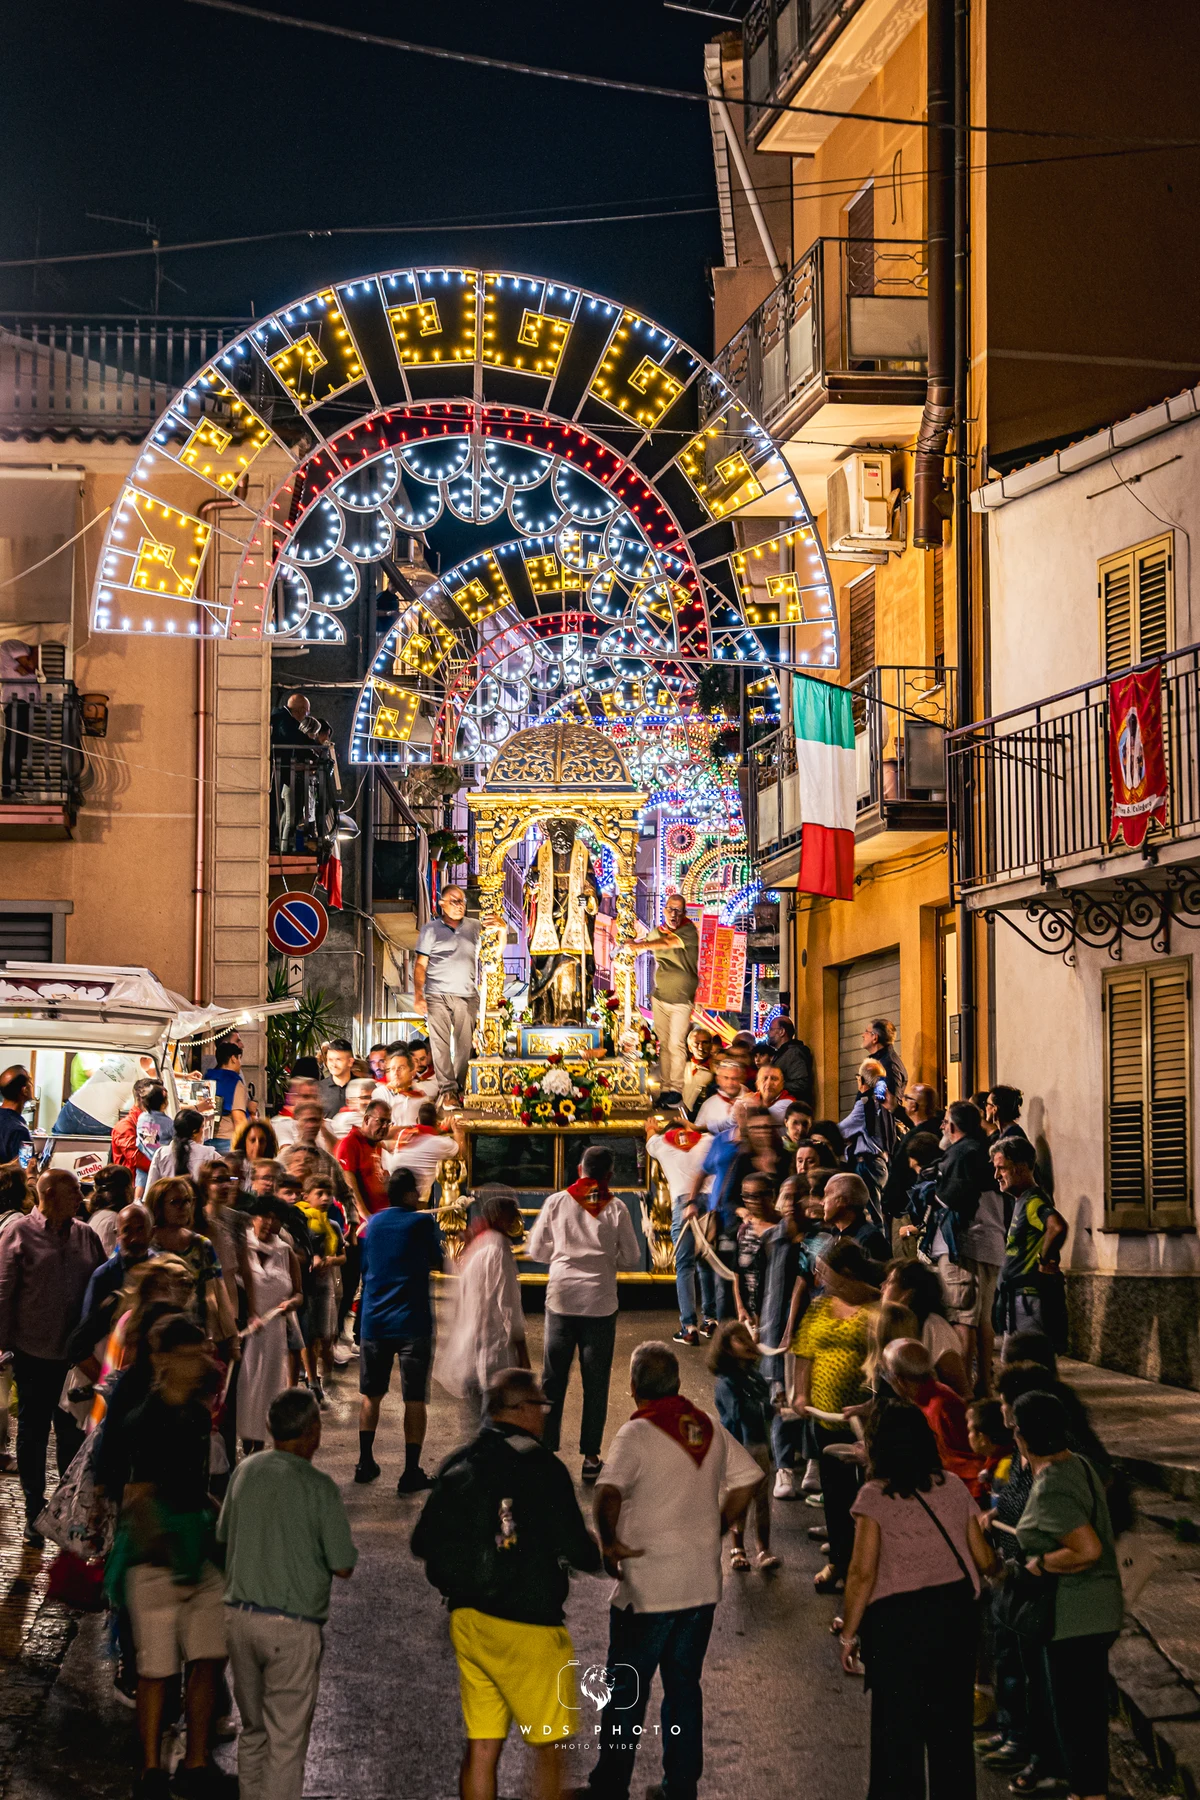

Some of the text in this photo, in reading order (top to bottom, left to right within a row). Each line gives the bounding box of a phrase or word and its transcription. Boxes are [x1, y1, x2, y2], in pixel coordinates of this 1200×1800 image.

[698, 933, 710, 997] TRISCARI
[712, 943, 725, 1003] TRISCARI
[727, 948, 740, 1003] TRISCARI
[76, 1164, 103, 1177] nutella
